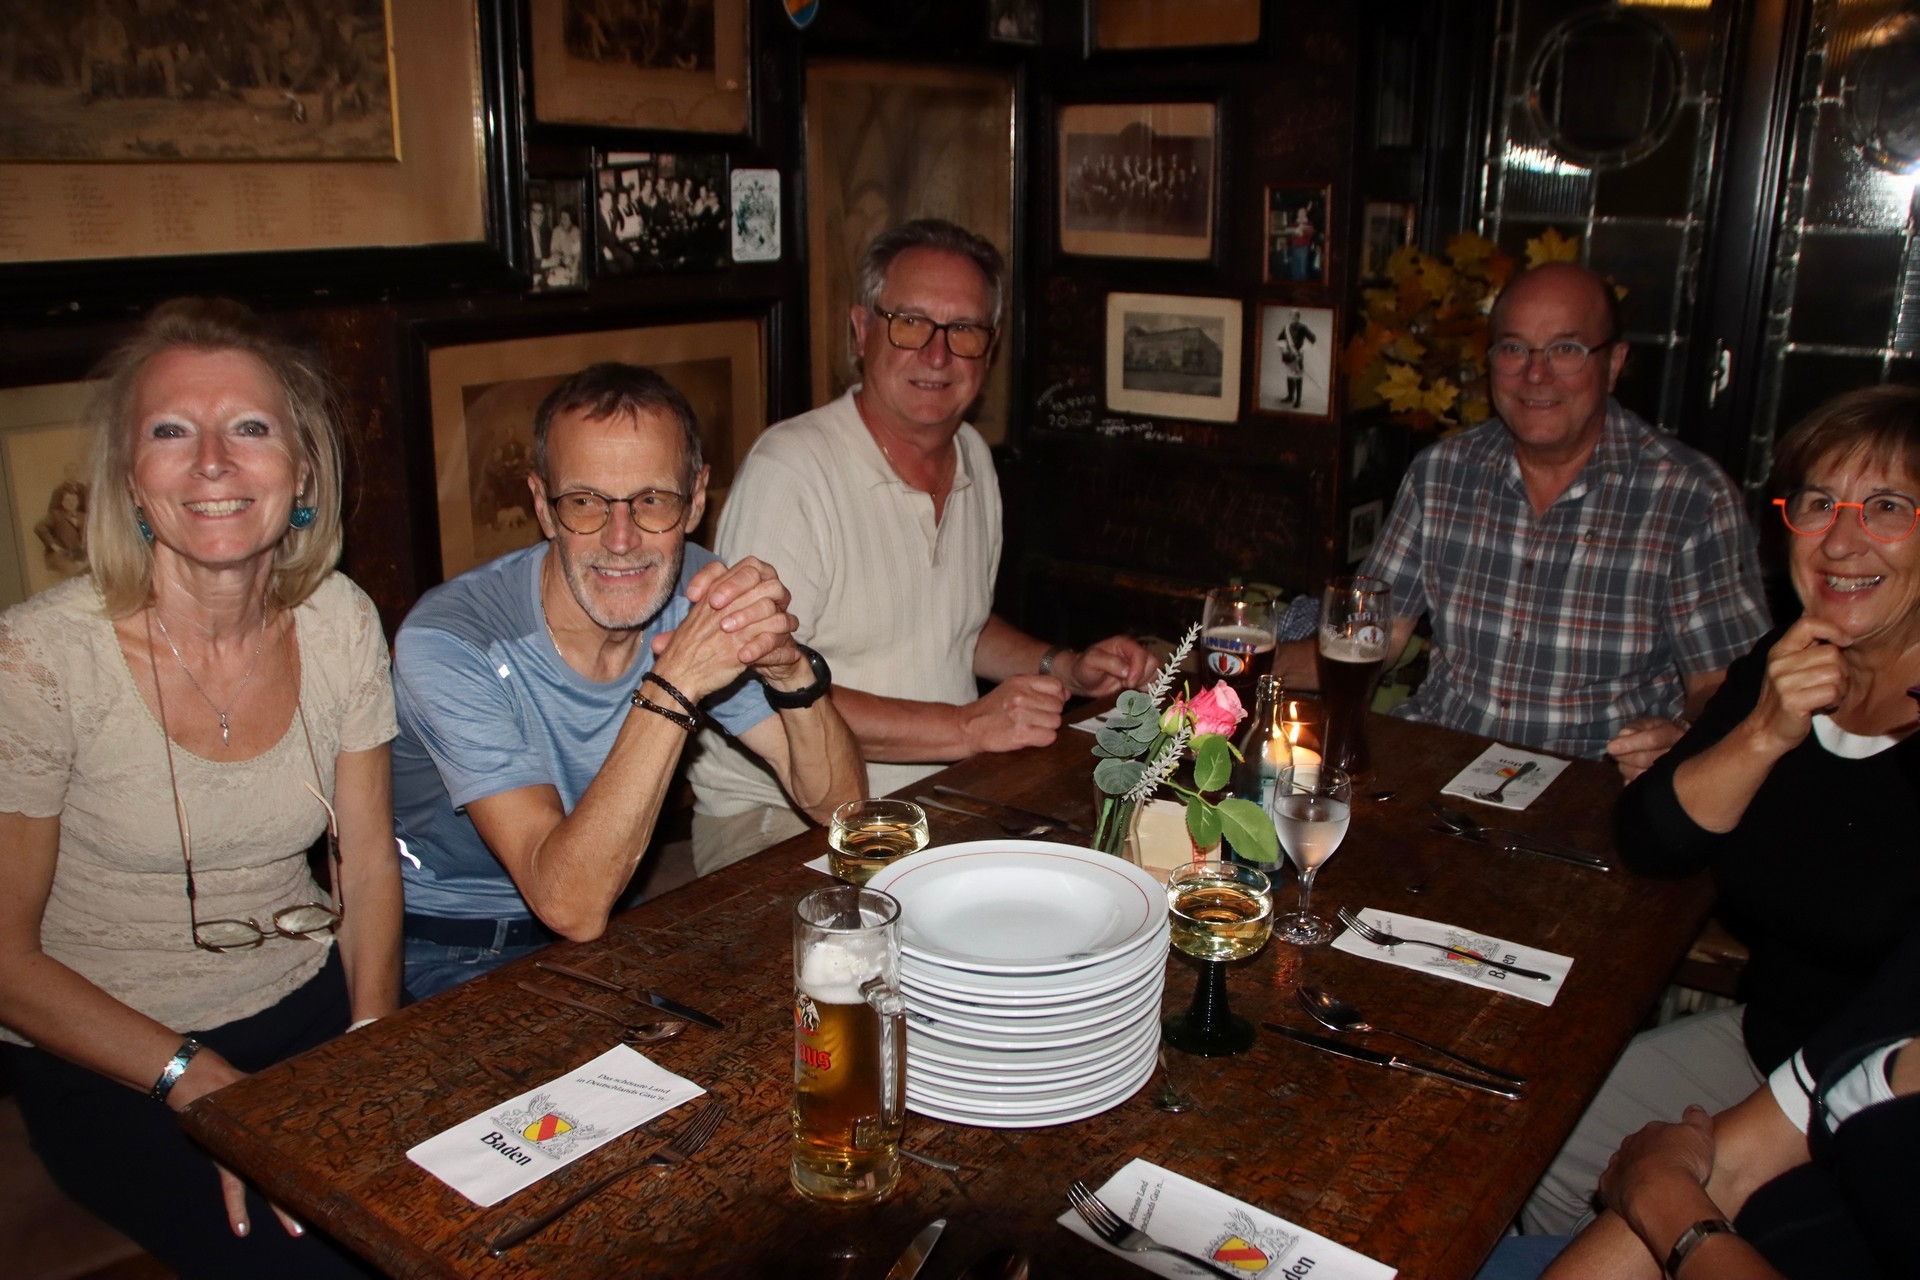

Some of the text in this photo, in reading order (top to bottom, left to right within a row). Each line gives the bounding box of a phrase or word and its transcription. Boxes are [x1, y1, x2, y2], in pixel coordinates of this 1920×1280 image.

[1489, 954, 1517, 980] Ben
[585, 1079, 638, 1095] Deutschlands
[597, 1073, 613, 1082] Das
[647, 1085, 671, 1096] Land
[480, 1131, 532, 1166] Baden
[1137, 1179, 1149, 1197] Land
